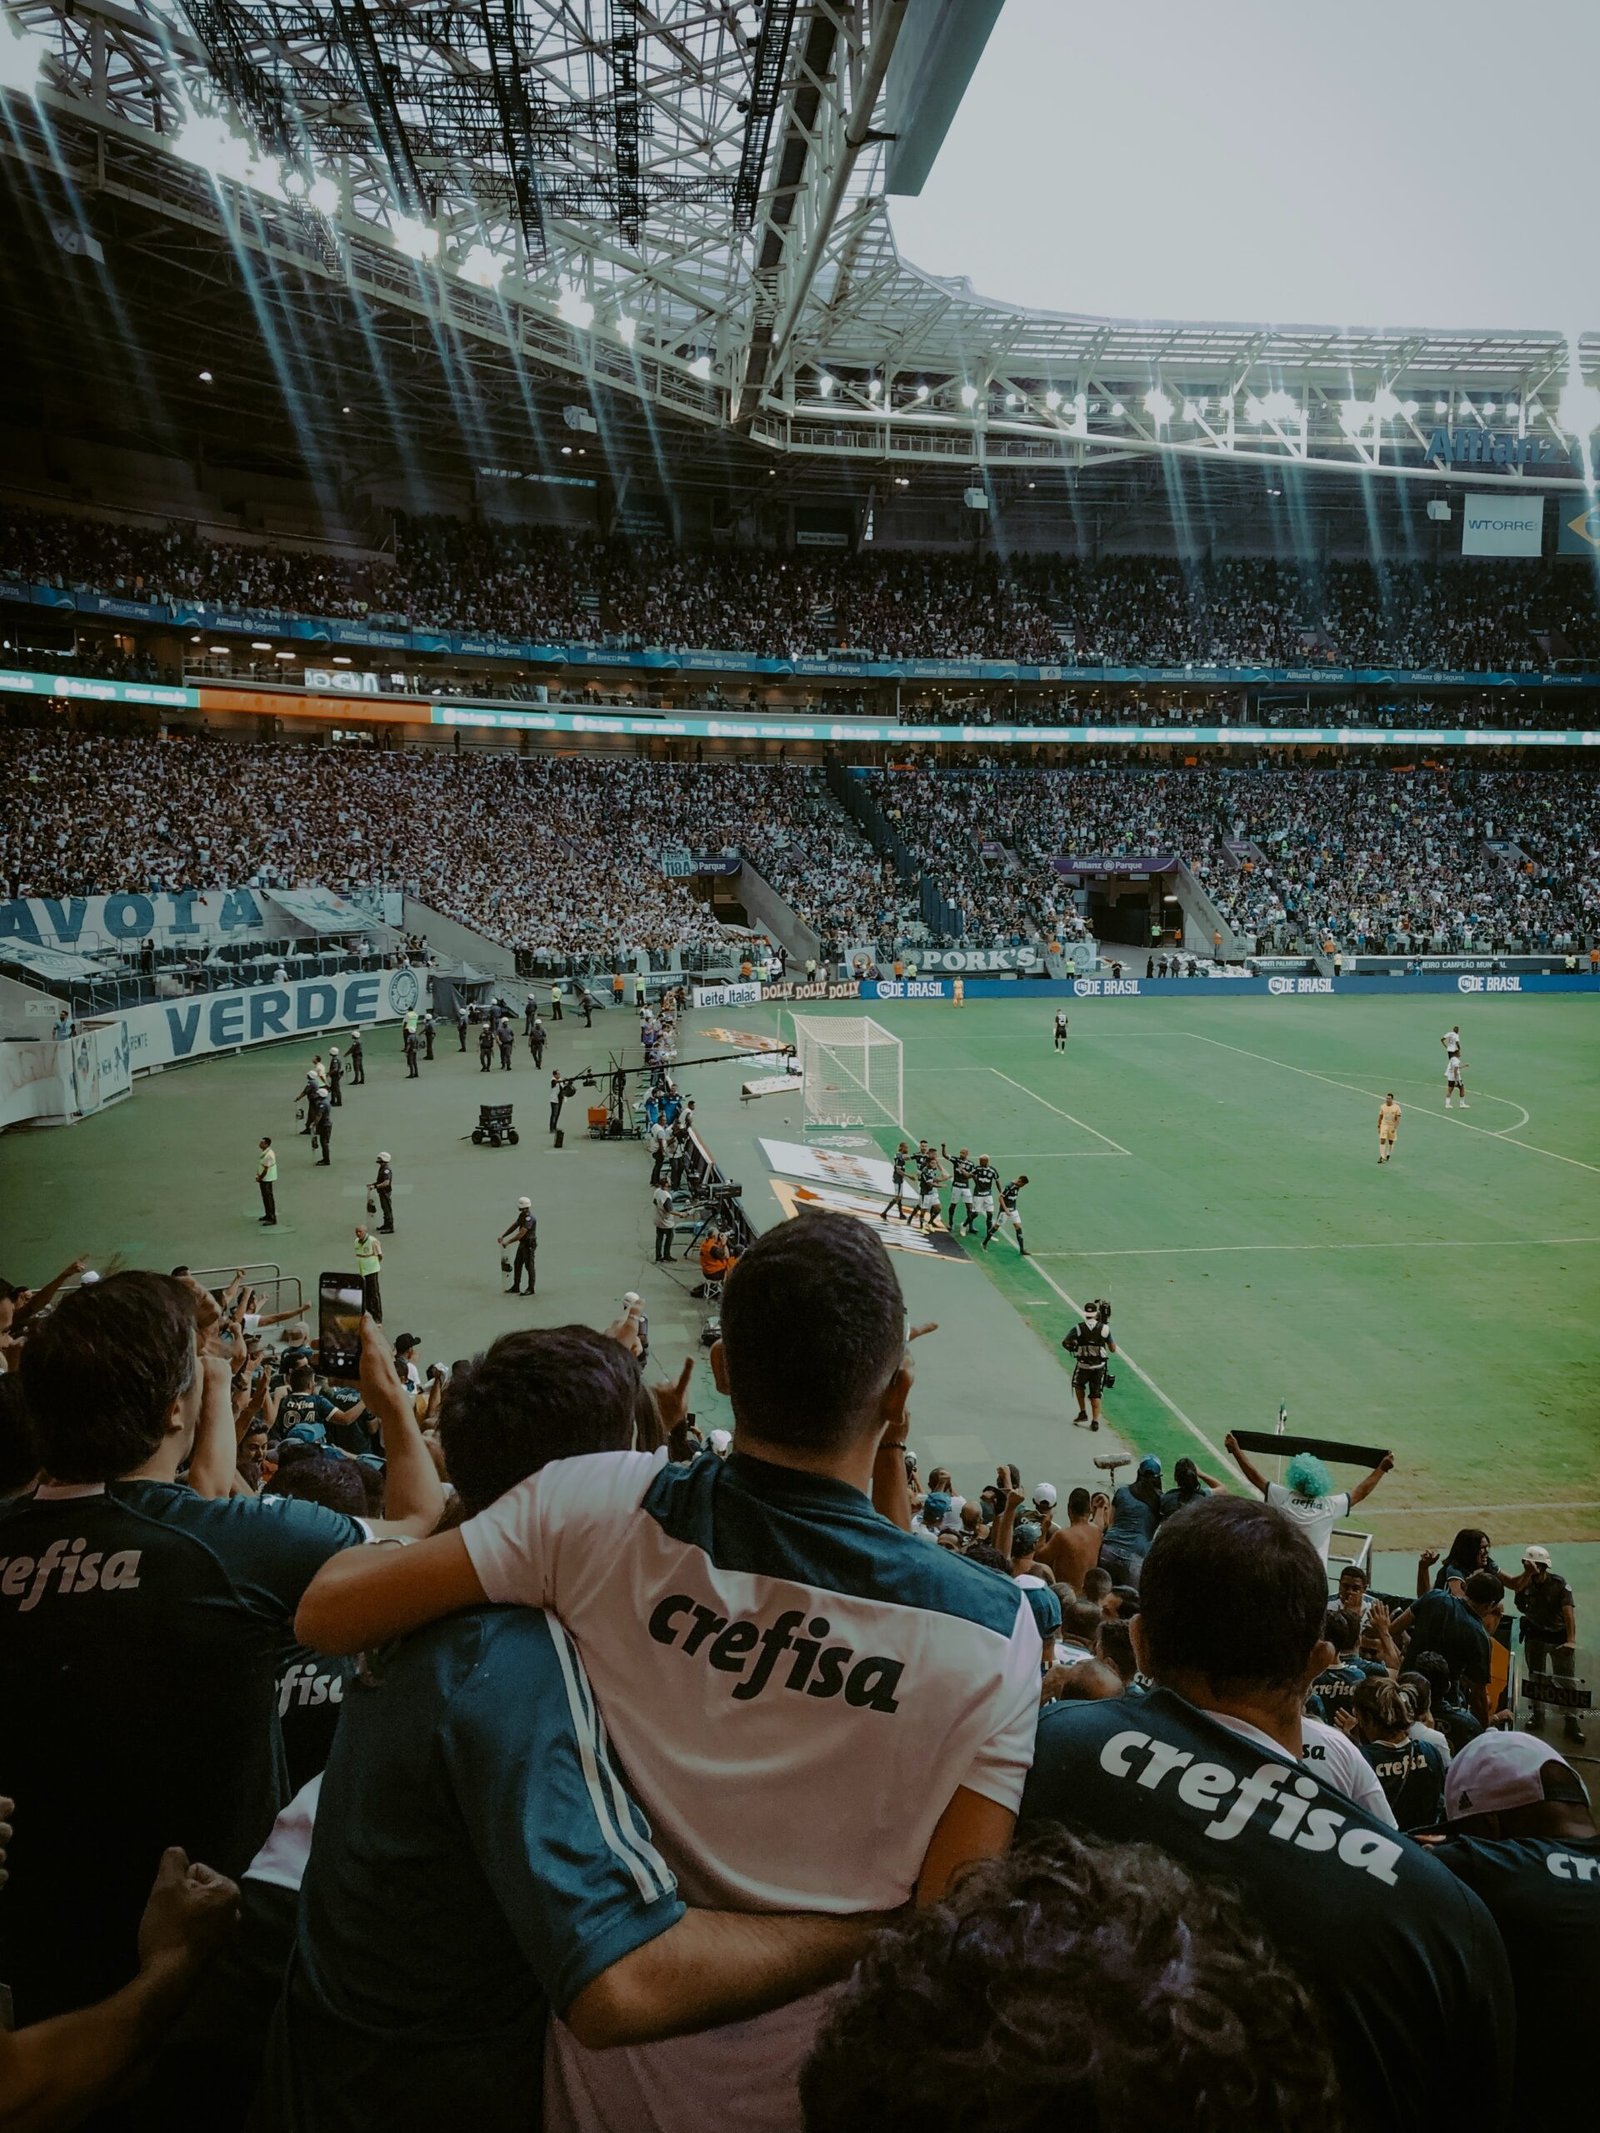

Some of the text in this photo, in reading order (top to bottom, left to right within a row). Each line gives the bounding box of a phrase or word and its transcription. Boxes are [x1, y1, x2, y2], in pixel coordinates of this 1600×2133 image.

[216, 618, 280, 633] Allianz Seguros
[340, 631, 404, 646] Allianz Parque
[461, 642, 521, 656] Allianz Seguros
[690, 657, 714, 667] Allianz
[802, 664, 860, 676] Allianz Parque
[914, 667, 937, 675] Allianz
[1161, 671, 1184, 679] Allianz
[1286, 672, 1344, 681] Allianz Parque
[1411, 673, 1432, 681] Allianz
[664, 860, 691, 876] 118A
[699, 862, 726, 872] Parque
[1072, 861, 1143, 872] Allianz Parque
[891, 982, 904, 997] DE
[906, 982, 945, 997] BRASIL
[1088, 980, 1101, 994] DE
[1104, 980, 1141, 994] BRASIL
[1282, 978, 1296, 992] DE
[1297, 978, 1334, 992] BRASIL
[1472, 976, 1485, 991] DE
[1486, 976, 1522, 991] BRASIL
[700, 988, 756, 1006] Leite Italac
[762, 982, 860, 1000] DOLLY DOLLY DOLLY
[165, 978, 381, 1056] VERDE
[648, 1594, 905, 1714] crefisa
[1376, 1754, 1428, 1781] crefsa
[1100, 1730, 1404, 1887] crefisa
